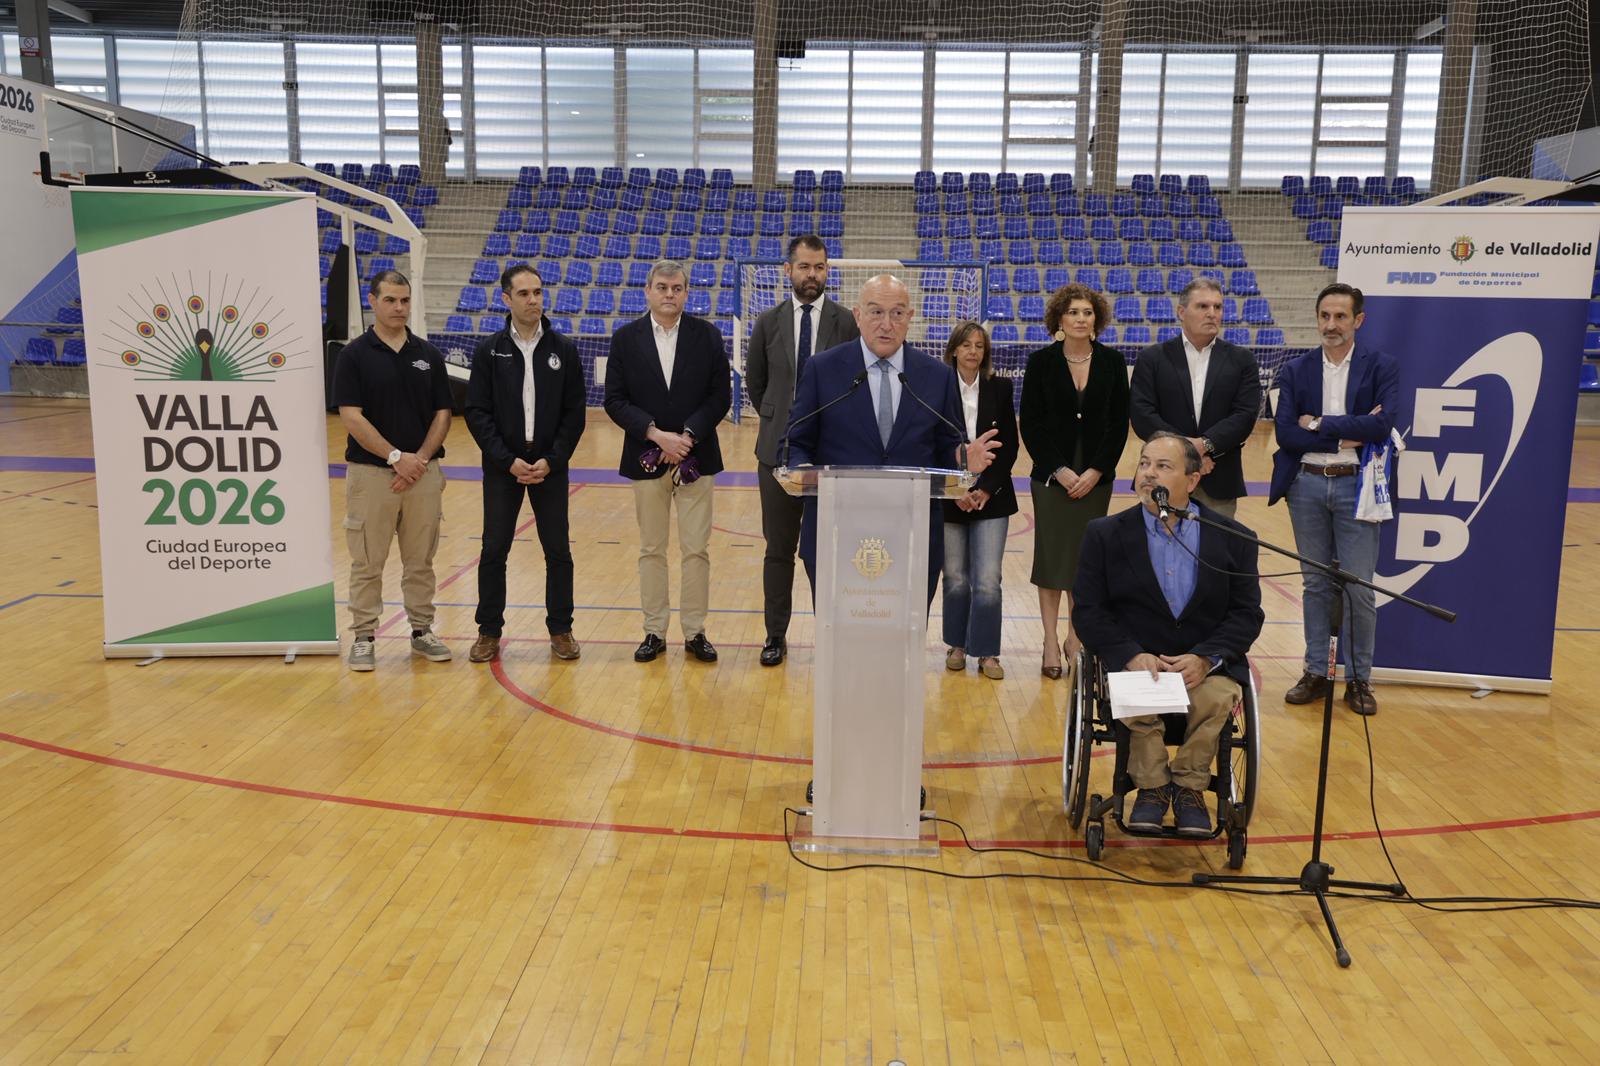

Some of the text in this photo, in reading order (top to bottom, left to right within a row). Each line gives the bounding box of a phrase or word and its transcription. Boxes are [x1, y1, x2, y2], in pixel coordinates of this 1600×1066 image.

[0, 83, 34, 113] 2026
[1345, 242, 1592, 257] Ayuntamiento de Valladolid
[1387, 271, 1437, 284] FMD
[136, 394, 279, 431] VALLA
[143, 436, 281, 473] DOLID
[142, 478, 285, 525] 2026
[146, 539, 287, 555] Ciudad Europea
[168, 556, 271, 572] del Deporte
